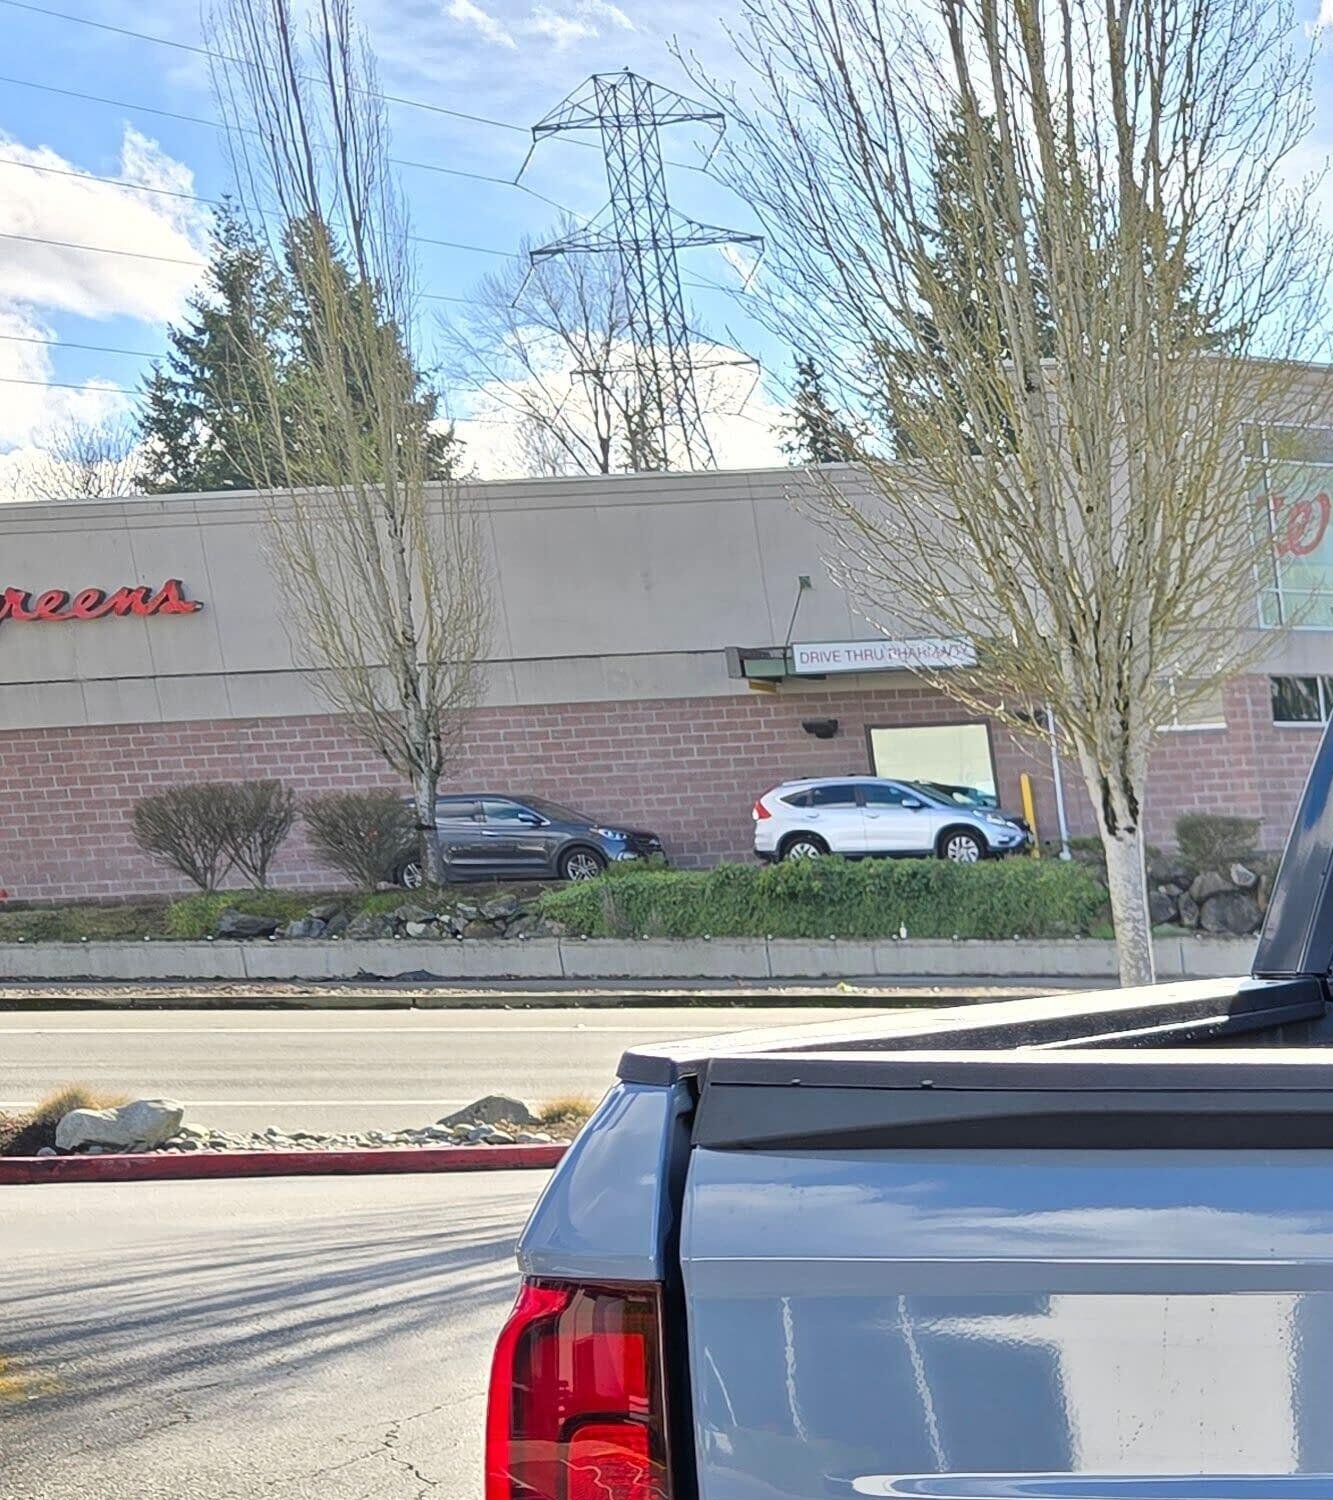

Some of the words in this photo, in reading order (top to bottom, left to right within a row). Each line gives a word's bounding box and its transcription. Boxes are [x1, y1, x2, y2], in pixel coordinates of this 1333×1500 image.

[0, 578, 204, 623] reens
[799, 650, 842, 665] DRIVE
[846, 646, 884, 663] THRU
